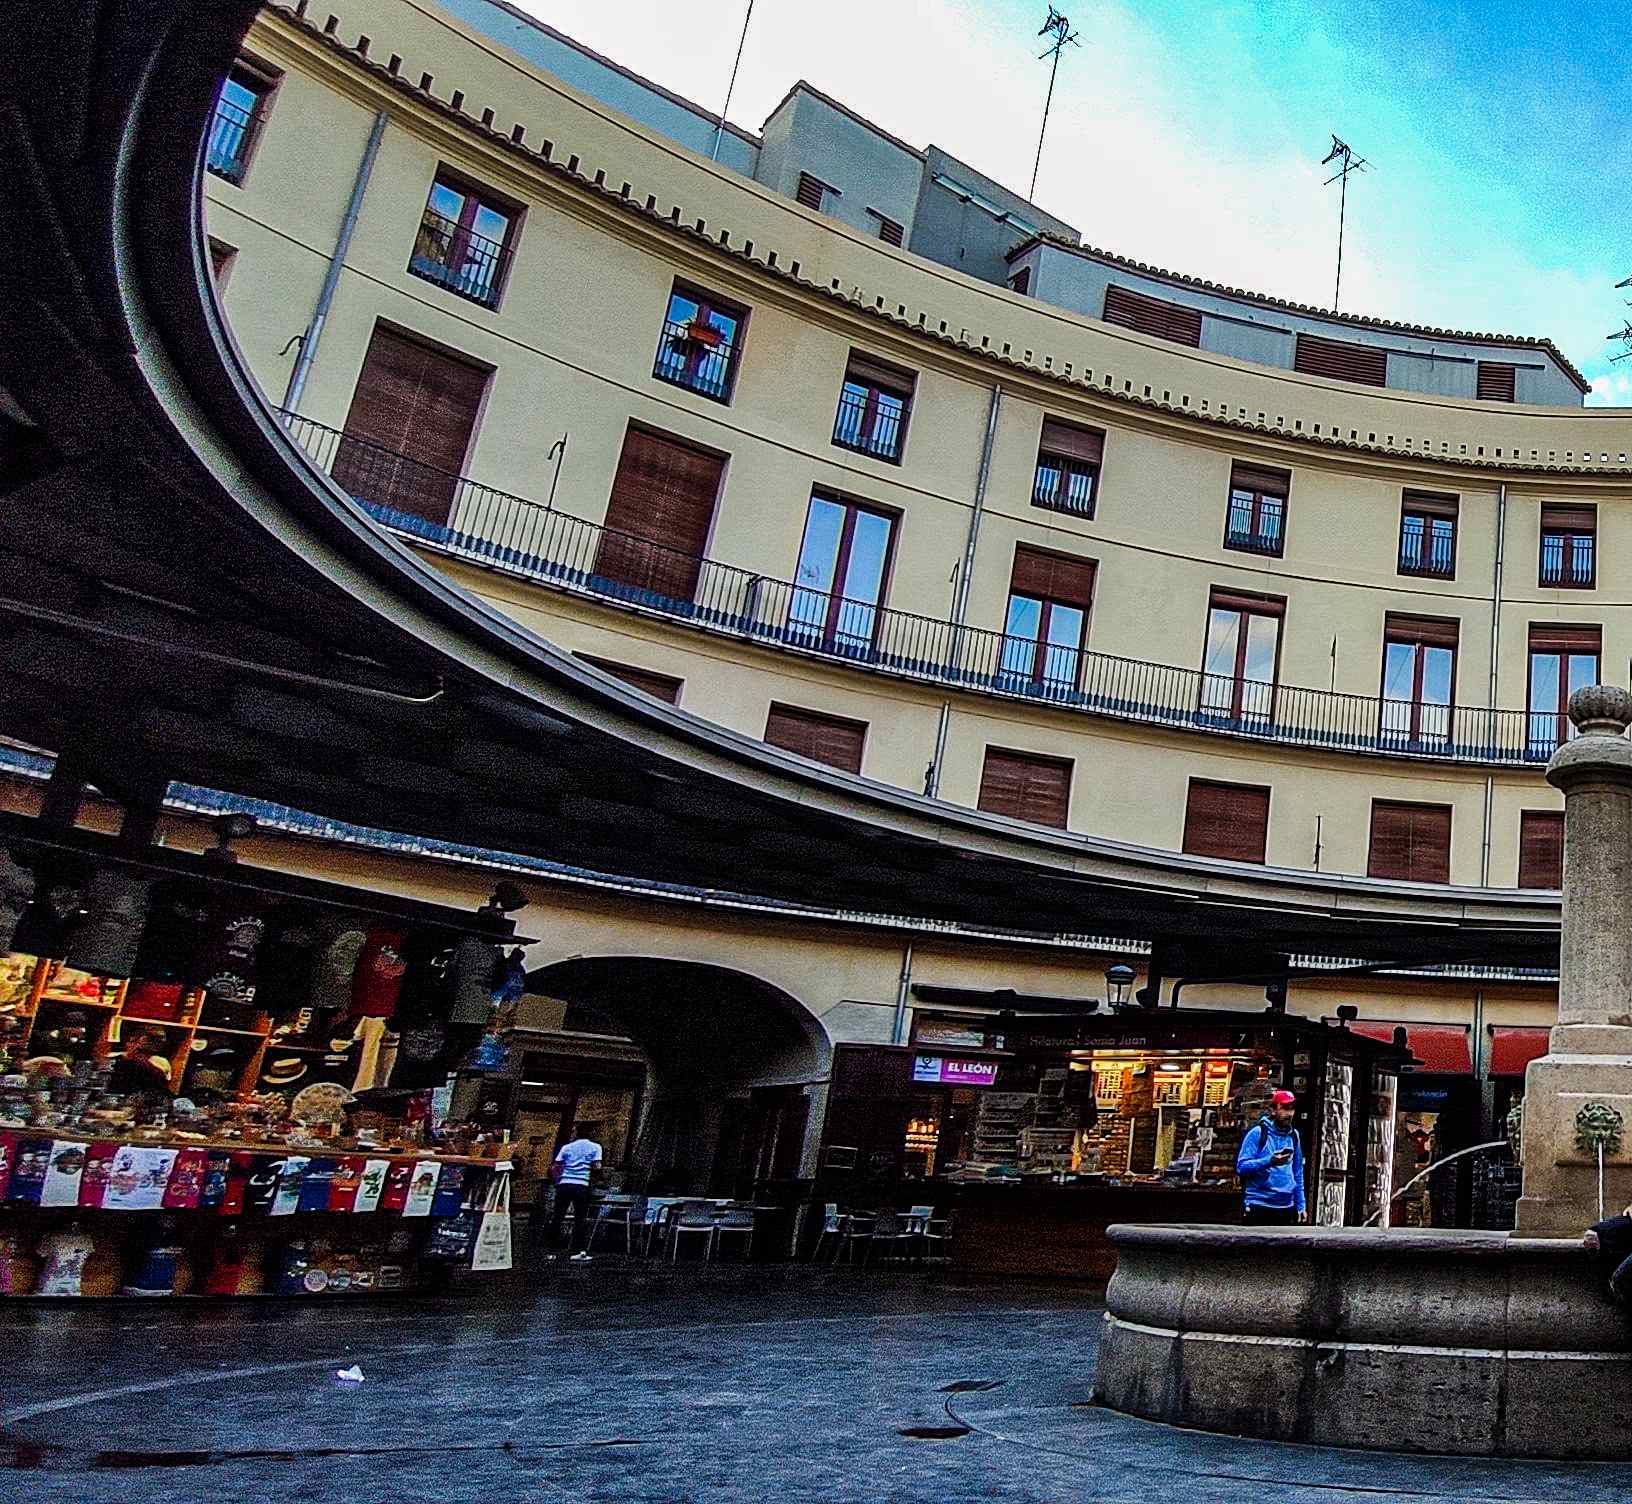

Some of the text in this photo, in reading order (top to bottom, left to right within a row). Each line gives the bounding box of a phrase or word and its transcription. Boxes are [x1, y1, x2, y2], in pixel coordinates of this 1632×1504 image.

[1118, 1033, 1148, 1047] Juan
[1237, 1033, 1247, 1045] 7
[947, 1062, 960, 1073] EL
[962, 1061, 993, 1075] LEÓN
